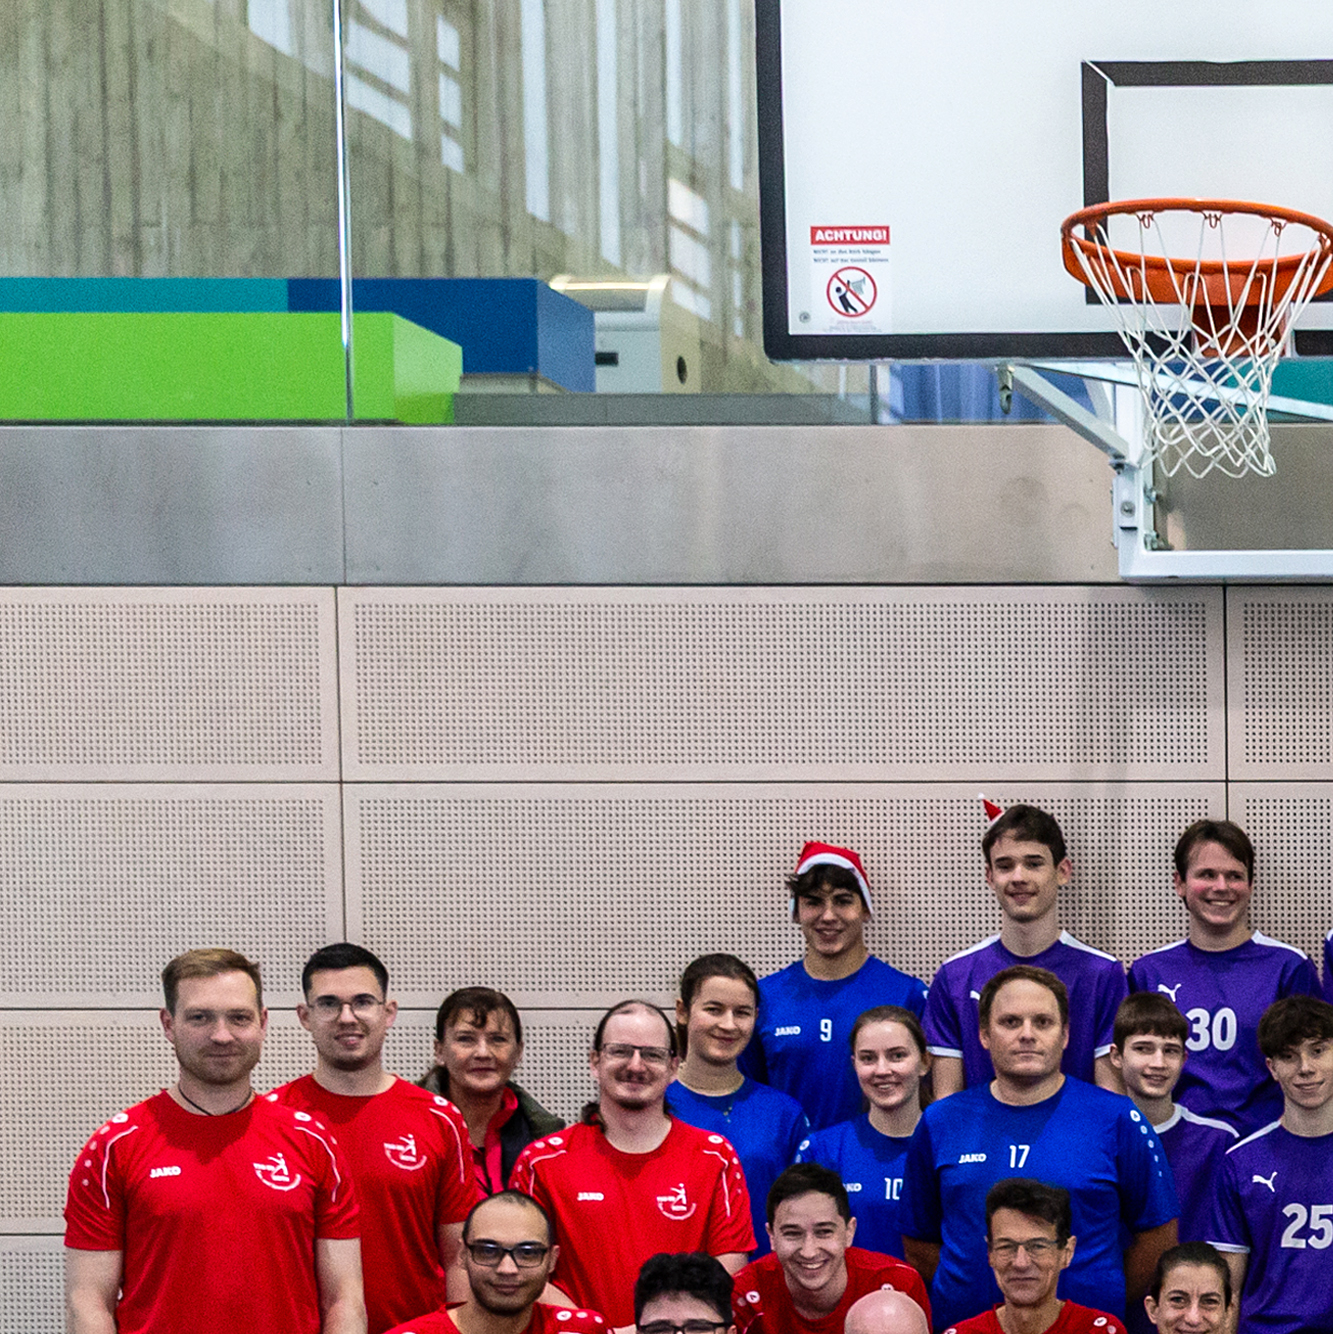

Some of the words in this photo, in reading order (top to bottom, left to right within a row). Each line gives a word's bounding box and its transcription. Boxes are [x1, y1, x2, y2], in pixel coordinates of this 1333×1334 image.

[815, 228, 888, 242] ACHTUNG!
[774, 1025, 801, 1037] JAKO
[820, 1018, 832, 1042] 9
[1184, 1007, 1238, 1052] 30
[957, 1153, 987, 1164] JAKO
[1009, 1144, 1031, 1169] 17
[150, 1166, 182, 1178] JAKO
